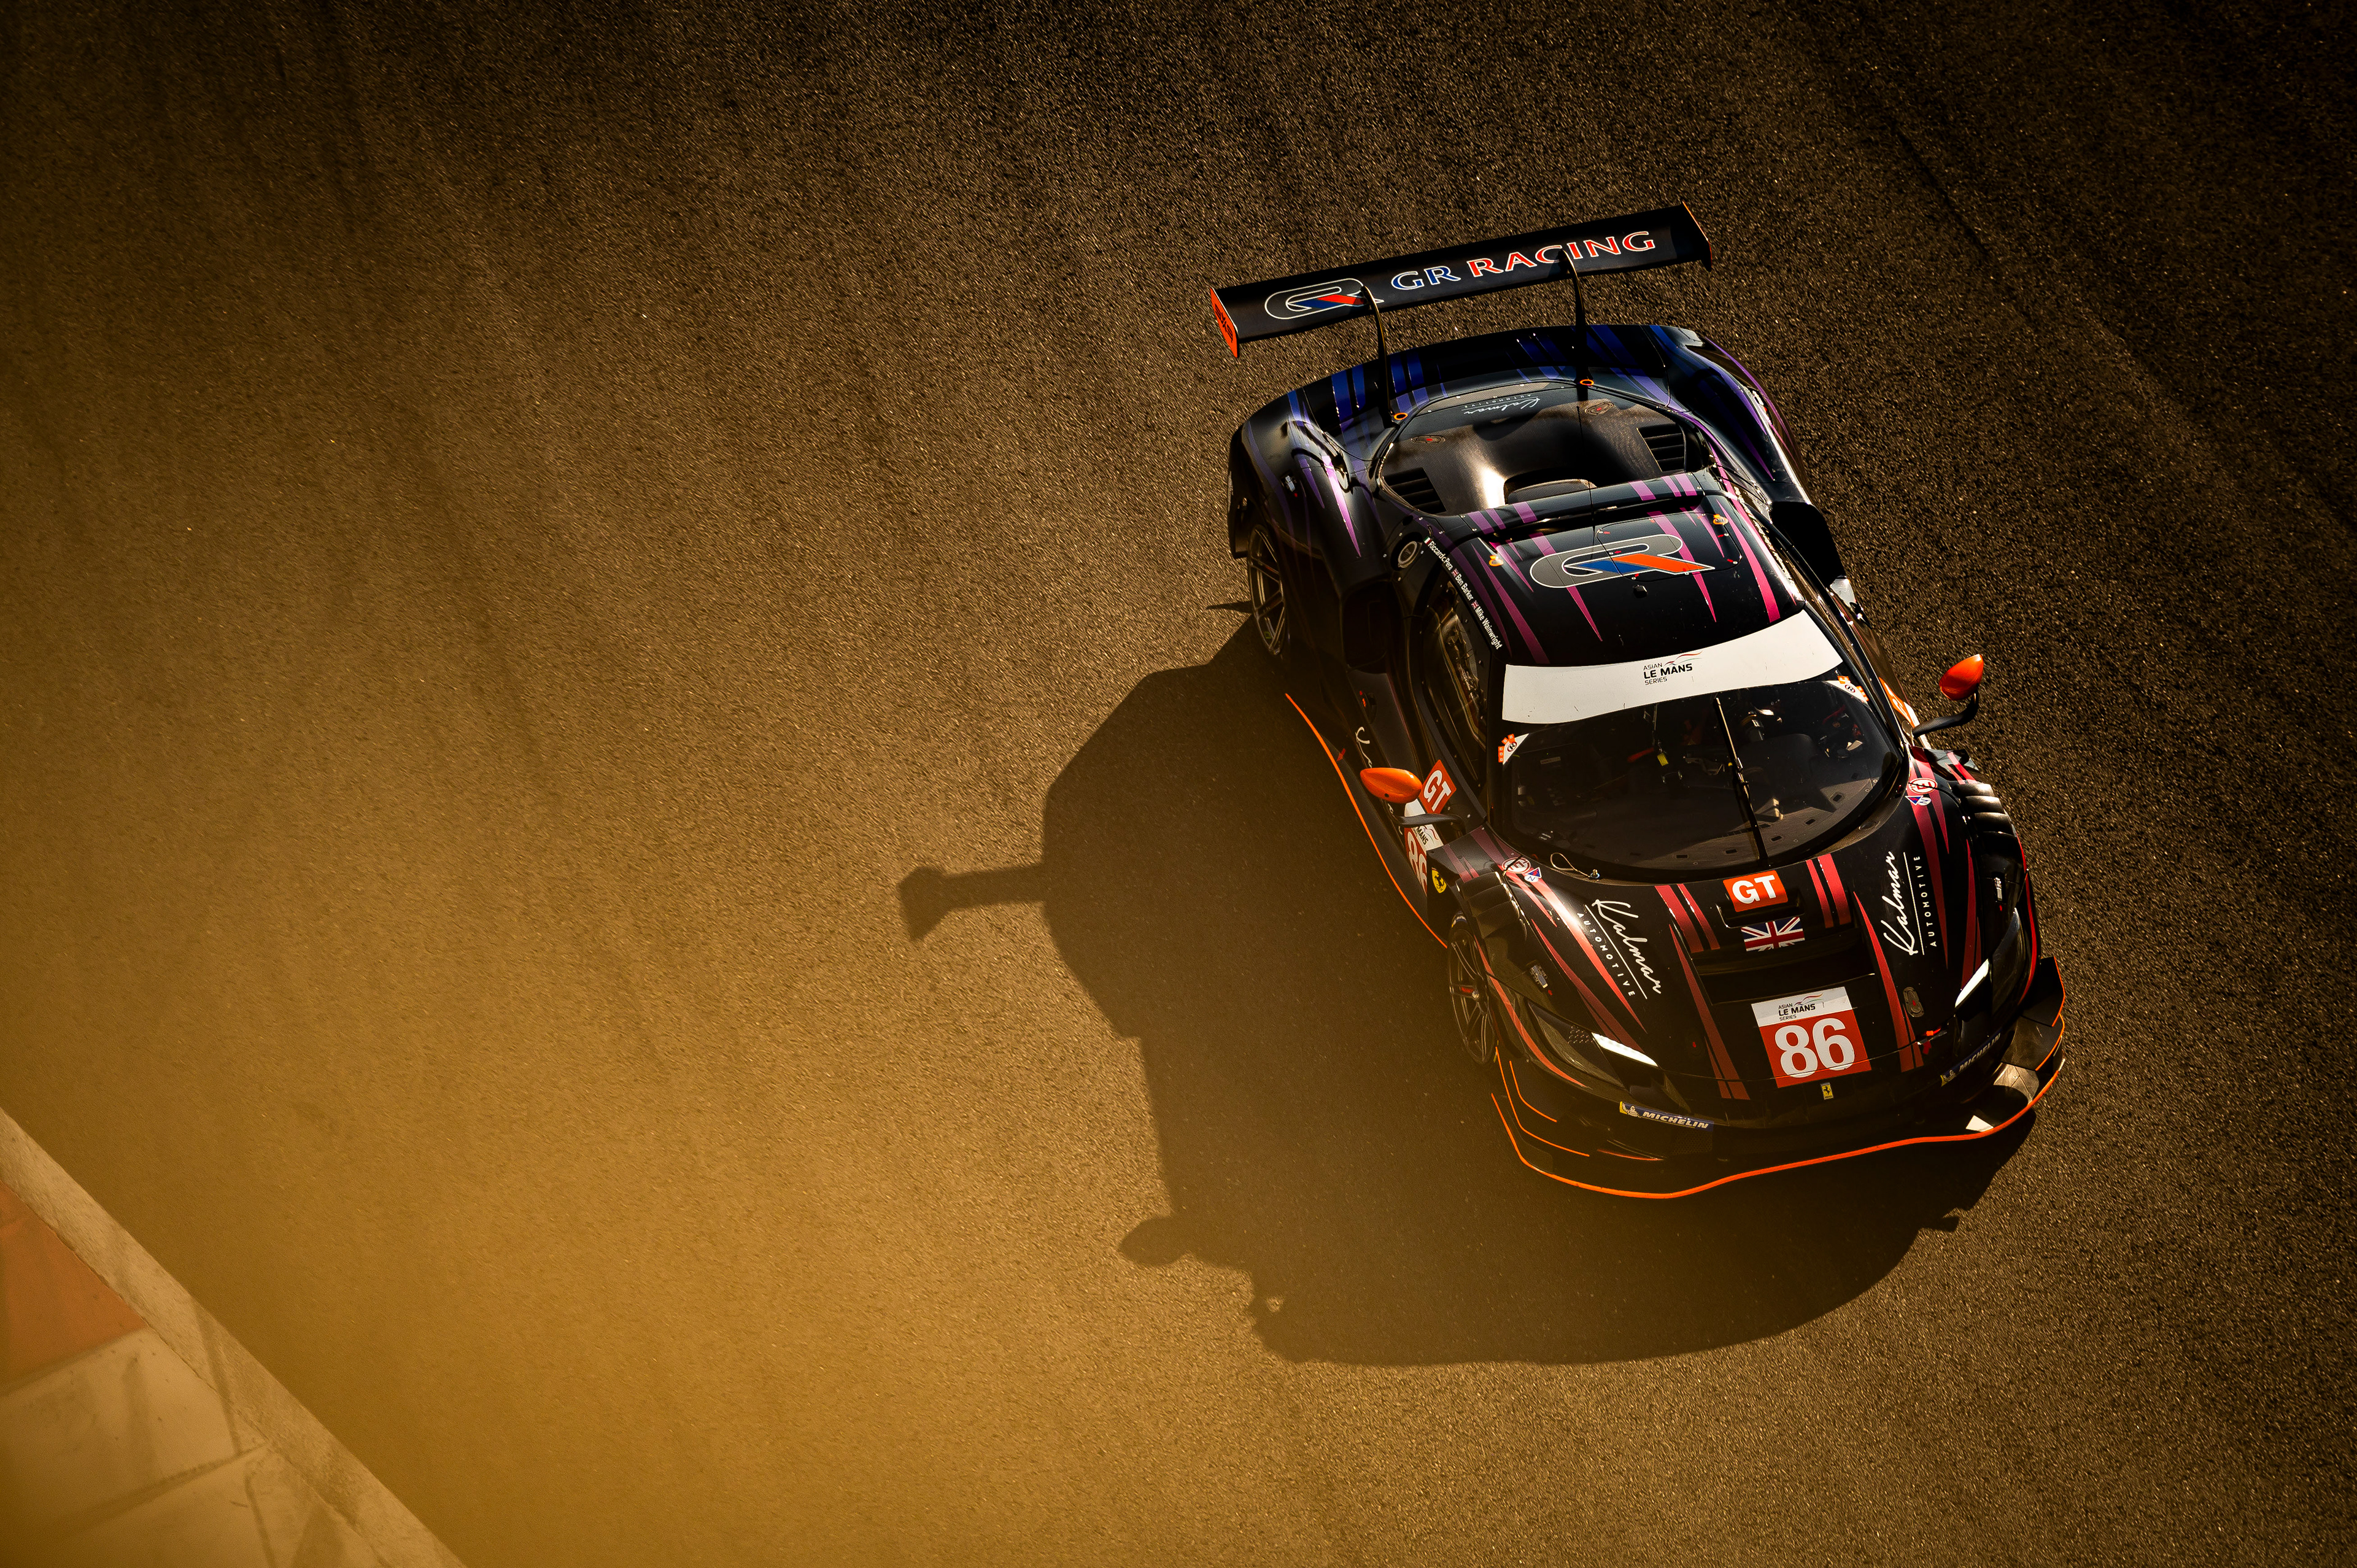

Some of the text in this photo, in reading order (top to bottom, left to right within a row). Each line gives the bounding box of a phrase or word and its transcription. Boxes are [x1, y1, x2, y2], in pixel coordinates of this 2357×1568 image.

[1391, 231, 1655, 290] GR RACING
[1444, 557, 1453, 571] Pera
[1455, 573, 1474, 601] Ben Barker
[1475, 606, 1503, 650] Mike Wainwright
[1643, 662, 1663, 671] ASIAN
[1644, 663, 1693, 679] LE MANS
[1644, 676, 1668, 686] SERIES
[1424, 770, 1452, 813] GT
[1732, 875, 1776, 904] GT
[1880, 851, 1919, 956] Kalman
[1913, 855, 1937, 947] AUTOMOTIVE
[1577, 913, 1636, 997] AUTOMOTIVE
[1591, 899, 1662, 994] Kalman
[1791, 1003, 1816, 1014] MANS
[1775, 1018, 1856, 1078] 86
[1643, 1111, 1709, 1129] MICHELIN
